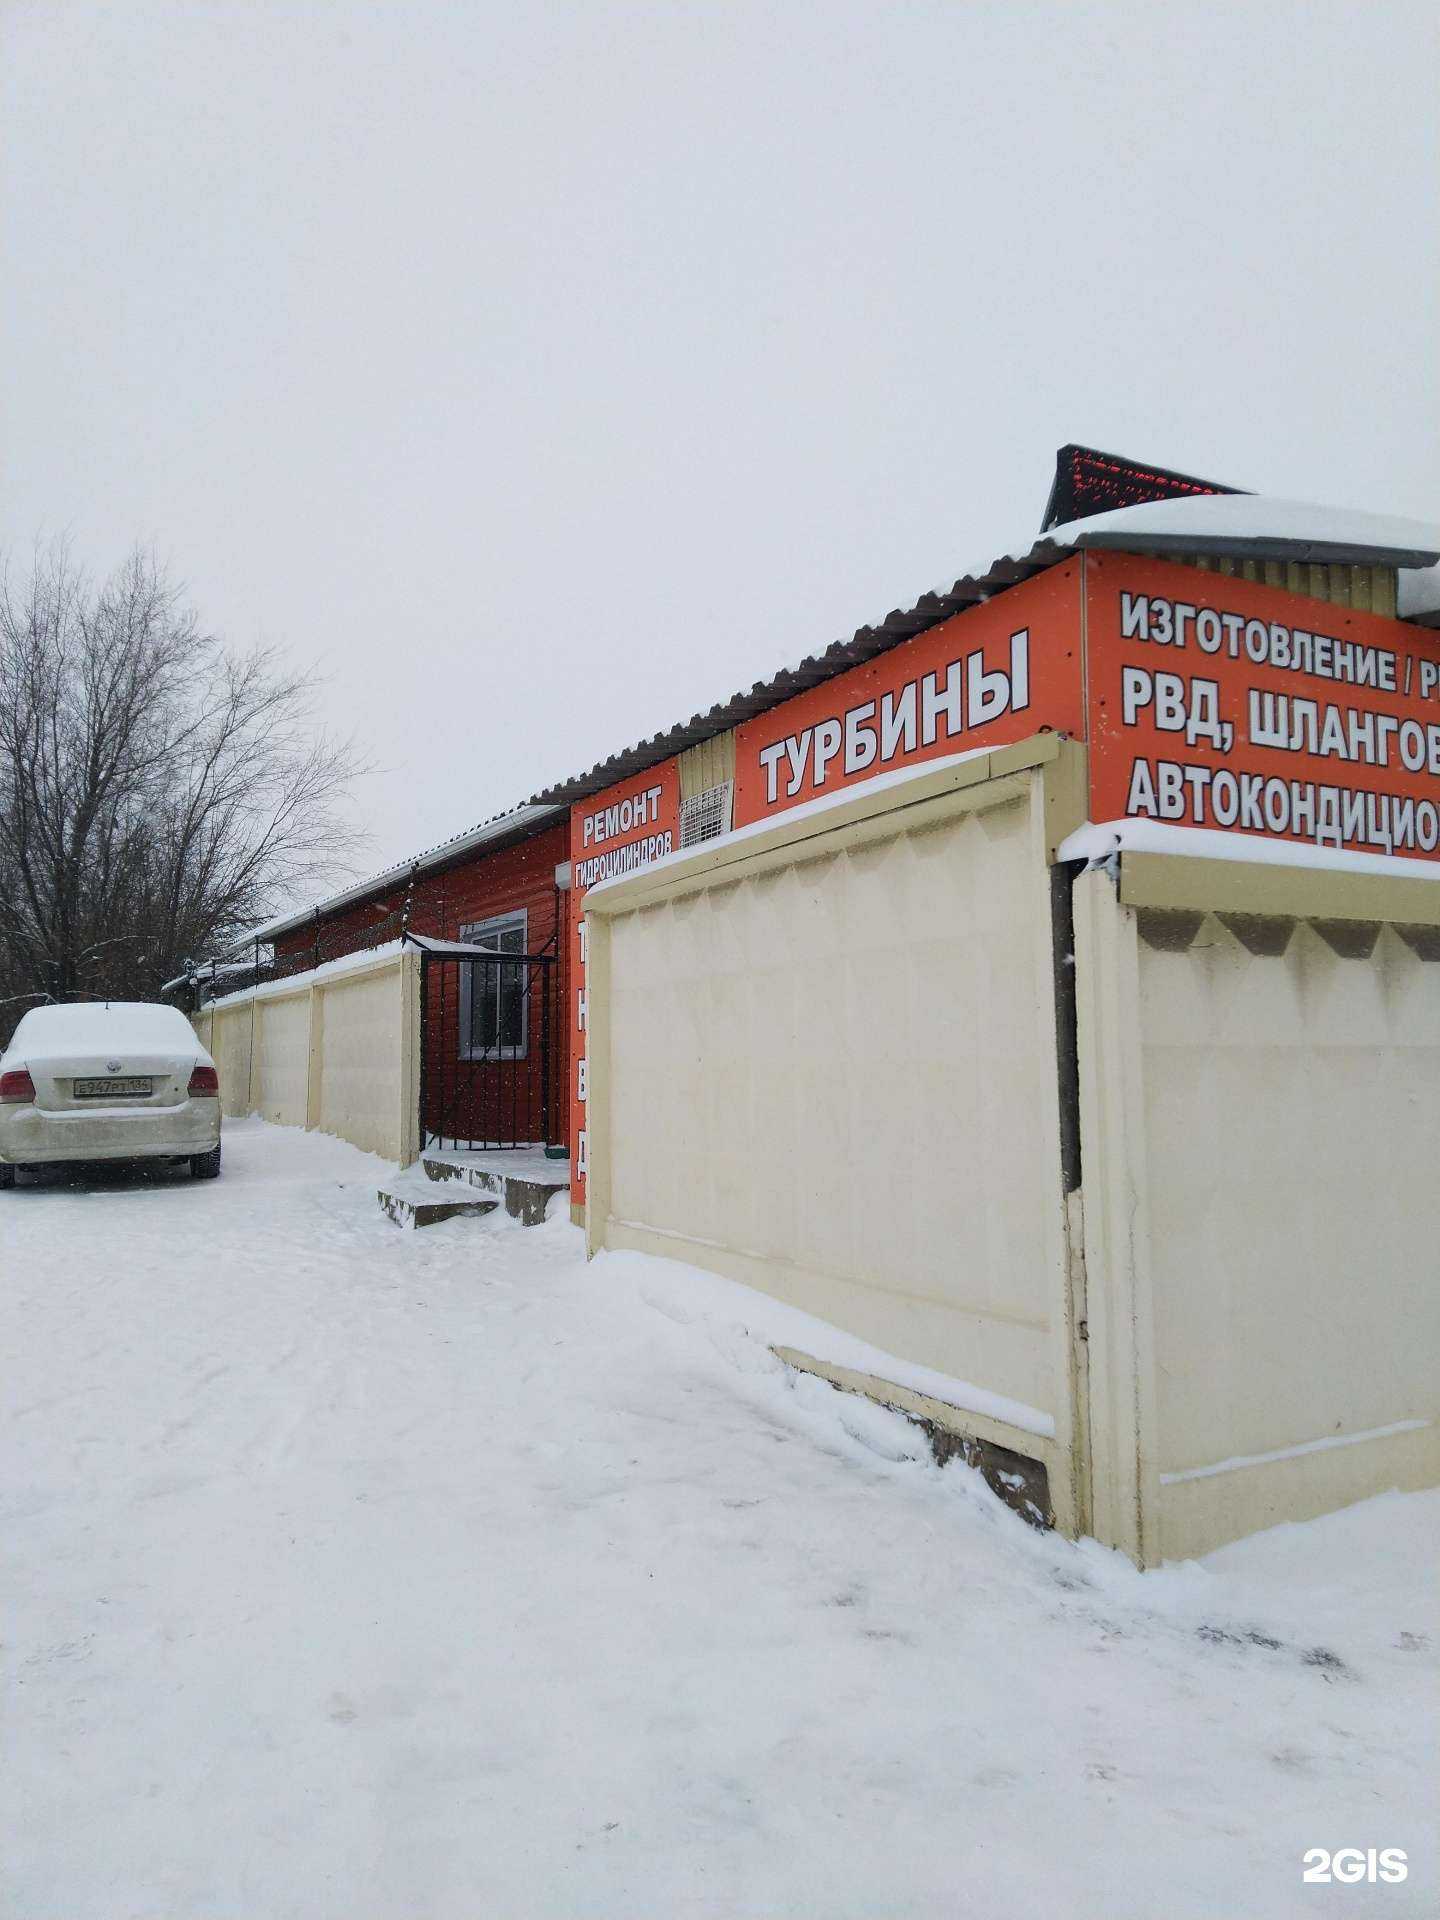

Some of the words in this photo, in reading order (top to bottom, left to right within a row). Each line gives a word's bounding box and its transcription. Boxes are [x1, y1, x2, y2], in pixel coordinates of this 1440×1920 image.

[1120, 591, 1397, 692] ИЗГОТОВЛЕНИЕ
[1419, 659, 1440, 699] Р
[759, 627, 1030, 804] ТУРБИНЫ
[1121, 665, 1234, 754] РВД,
[575, 830, 673, 890] ГИДРОЦИЛИНДРОВ
[583, 784, 662, 848] РЕМОНТ
